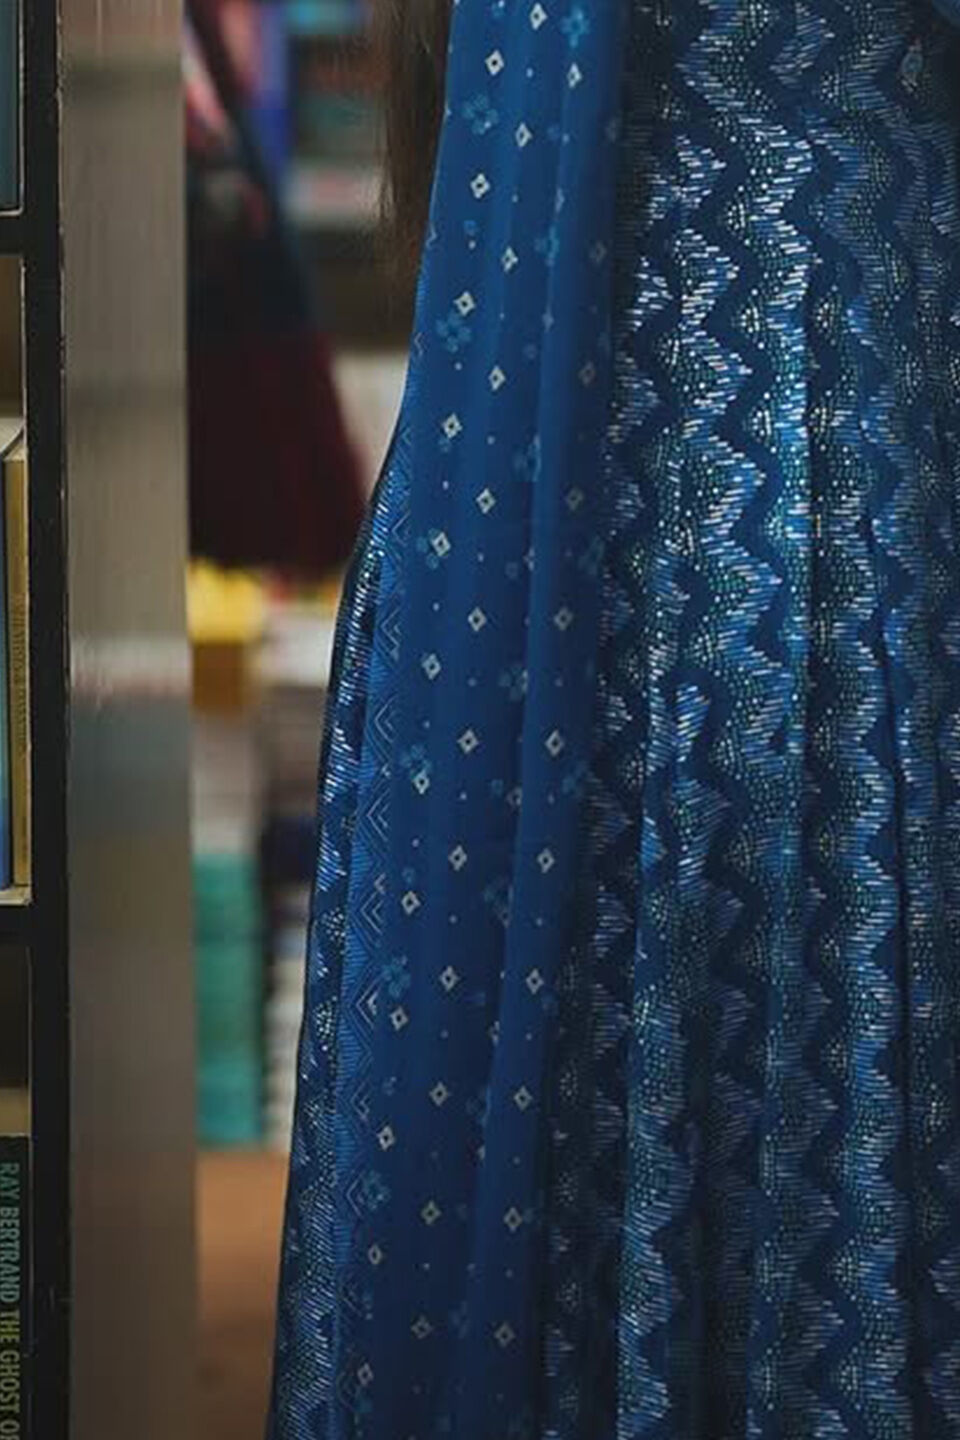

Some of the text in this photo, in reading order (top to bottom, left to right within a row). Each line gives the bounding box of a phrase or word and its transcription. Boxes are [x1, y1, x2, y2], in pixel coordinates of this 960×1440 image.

[0, 1162, 20, 1200] RAY
[0, 1207, 20, 1302] BERTRAND
[0, 1310, 20, 1343] THE
[0, 1350, 20, 1413] GHOST
